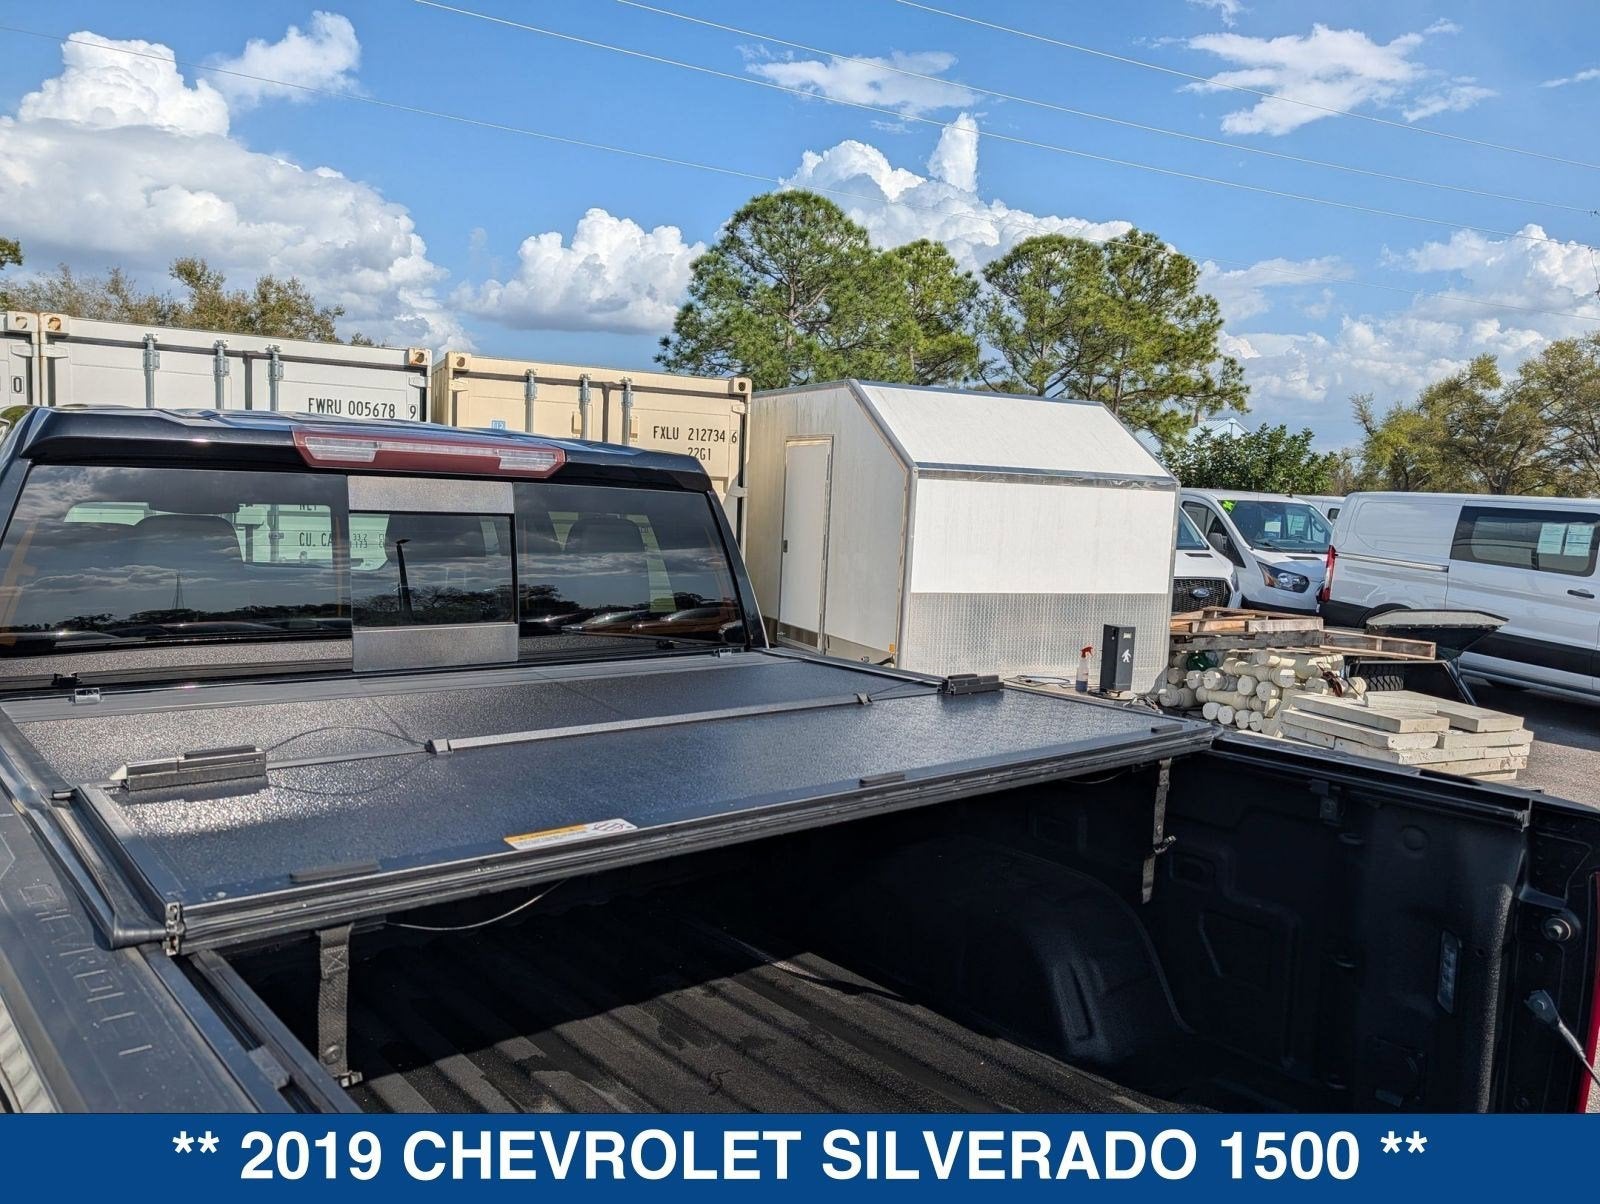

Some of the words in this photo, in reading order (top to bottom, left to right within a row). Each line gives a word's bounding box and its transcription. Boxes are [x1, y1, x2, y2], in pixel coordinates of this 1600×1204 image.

[308, 397, 342, 415] FWRU
[348, 400, 396, 419] 005678
[409, 405, 417, 419] 9
[653, 426, 679, 440] FXLU
[687, 428, 726, 442] 212734
[731, 431, 737, 444] 6
[321, 532, 334, 547] CA
